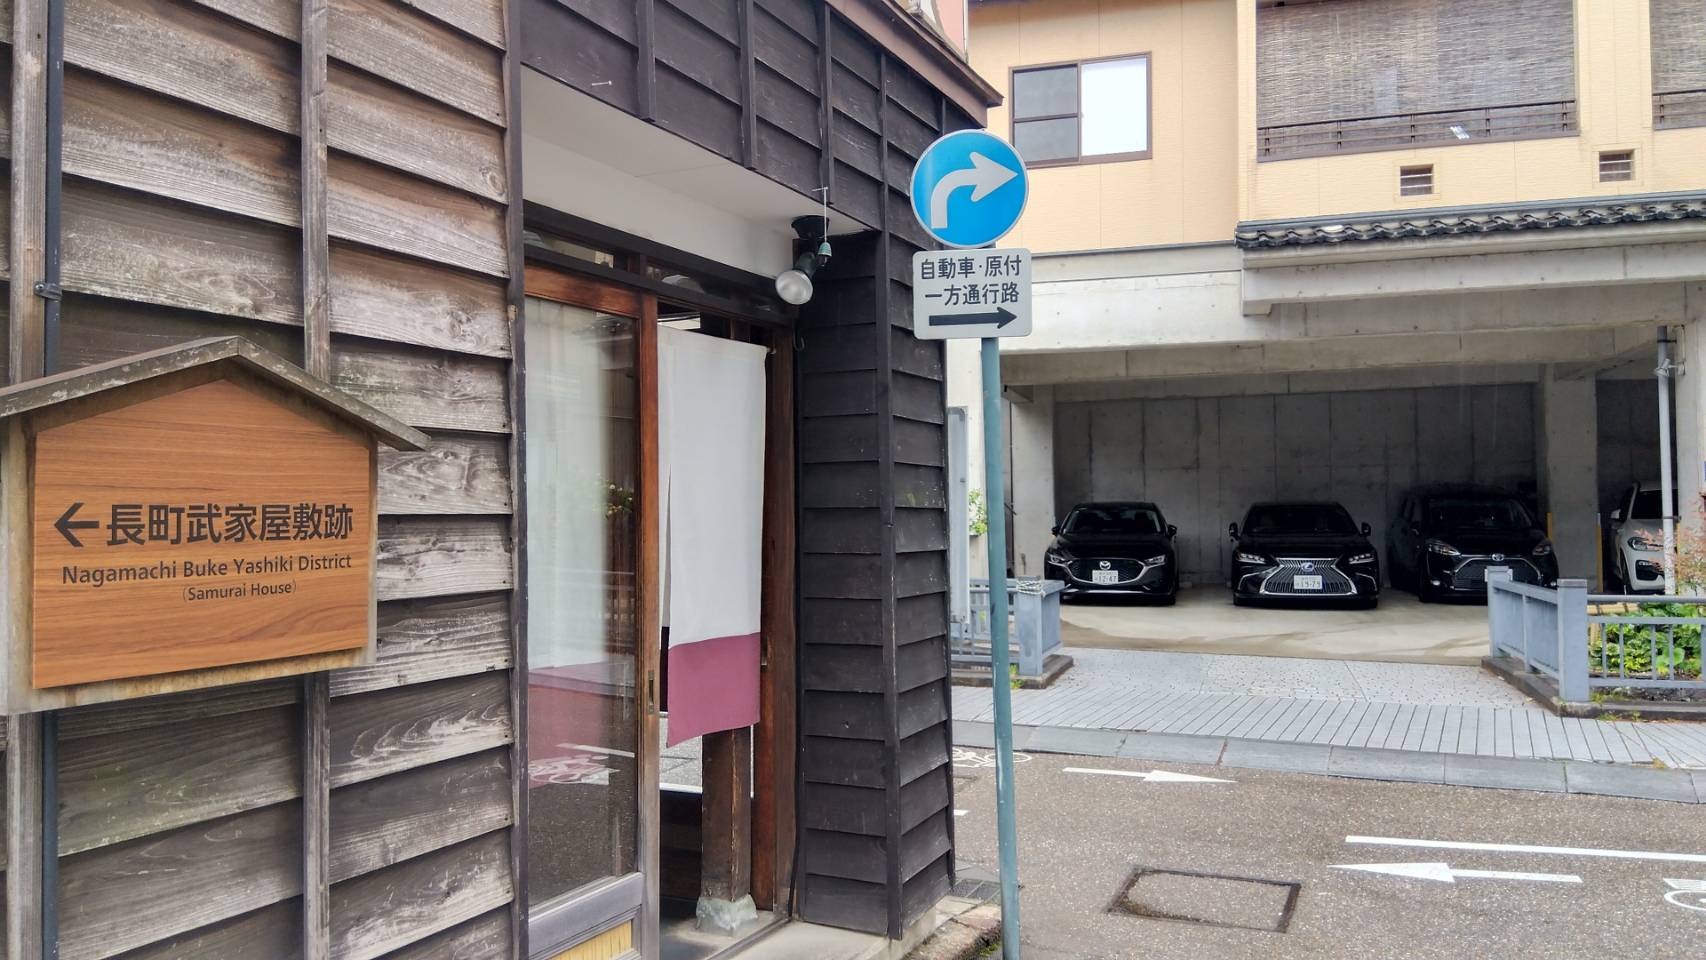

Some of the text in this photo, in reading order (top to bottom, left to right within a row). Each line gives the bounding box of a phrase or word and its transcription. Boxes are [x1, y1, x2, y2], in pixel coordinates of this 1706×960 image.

[925, 281, 1020, 306] 一方通行路
[106, 503, 354, 546] 長町武家屋敷跡
[62, 553, 352, 587] Nagamachi Buke Yashiki District
[182, 581, 297, 602] (Samurai House)
